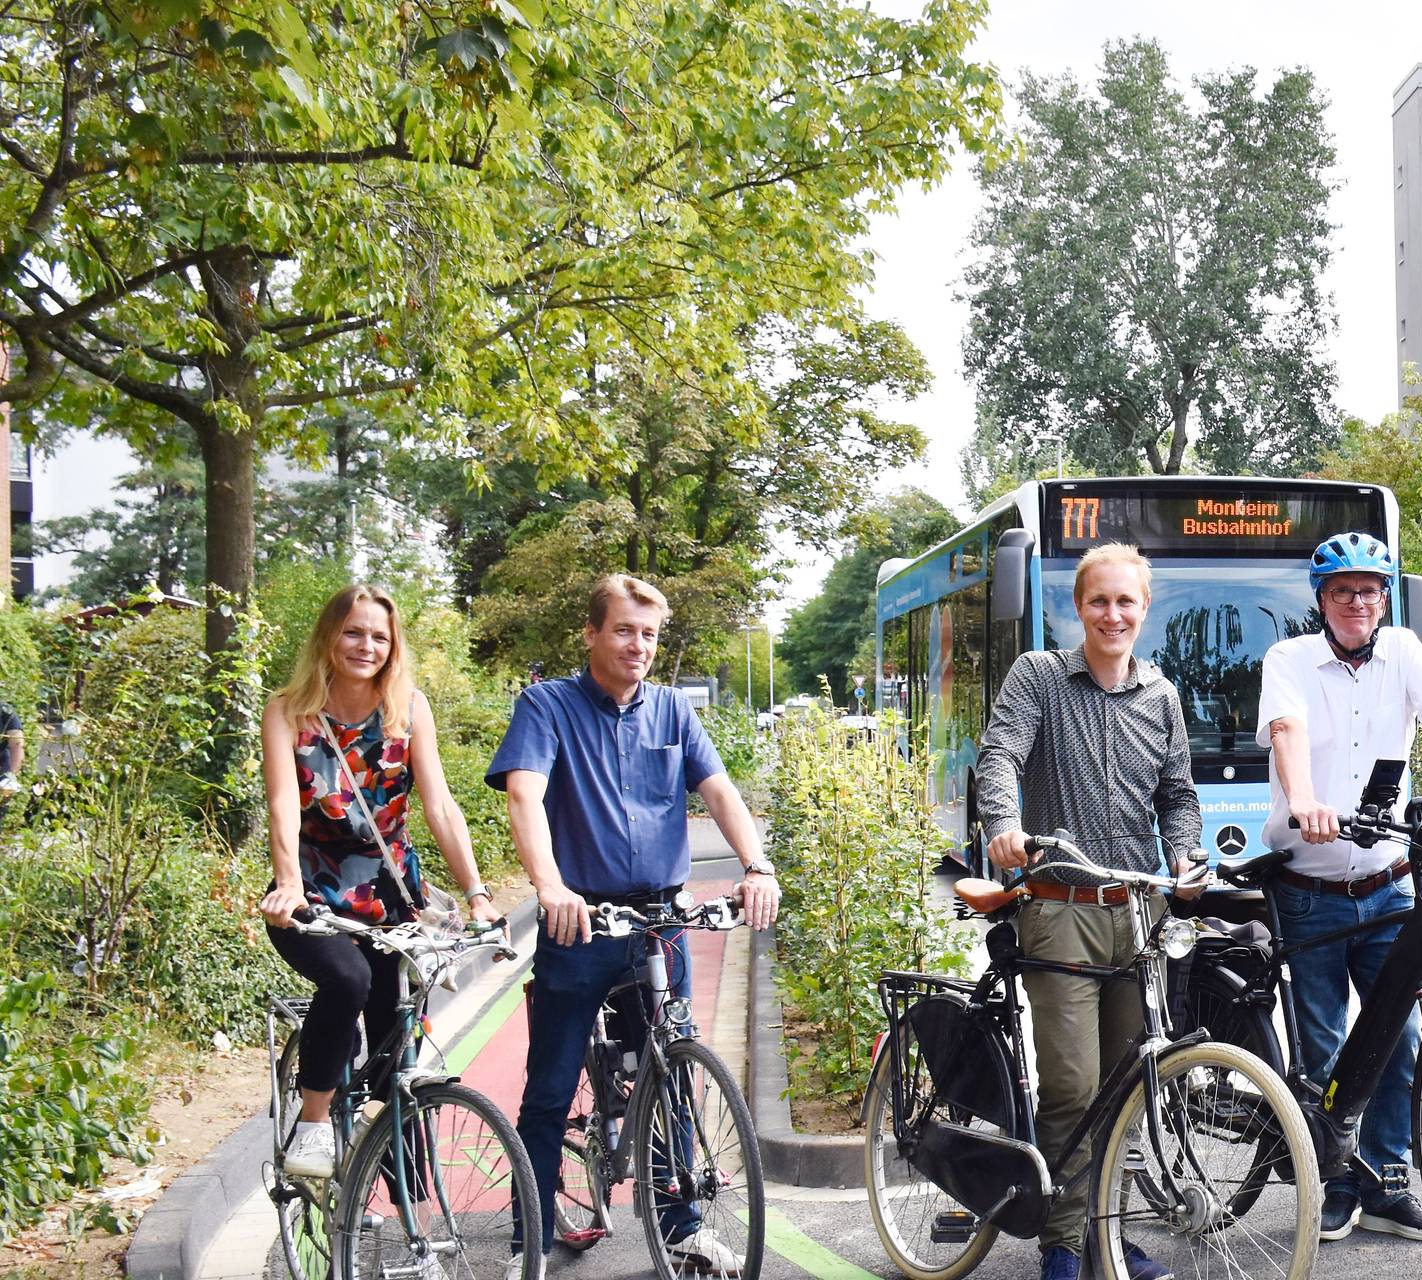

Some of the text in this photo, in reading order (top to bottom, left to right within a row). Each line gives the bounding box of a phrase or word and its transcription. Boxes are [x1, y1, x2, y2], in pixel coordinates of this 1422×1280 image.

[1198, 500, 1279, 516] Monheim
[1061, 498, 1100, 538] 777
[1183, 519, 1293, 536] Busbahnhof
